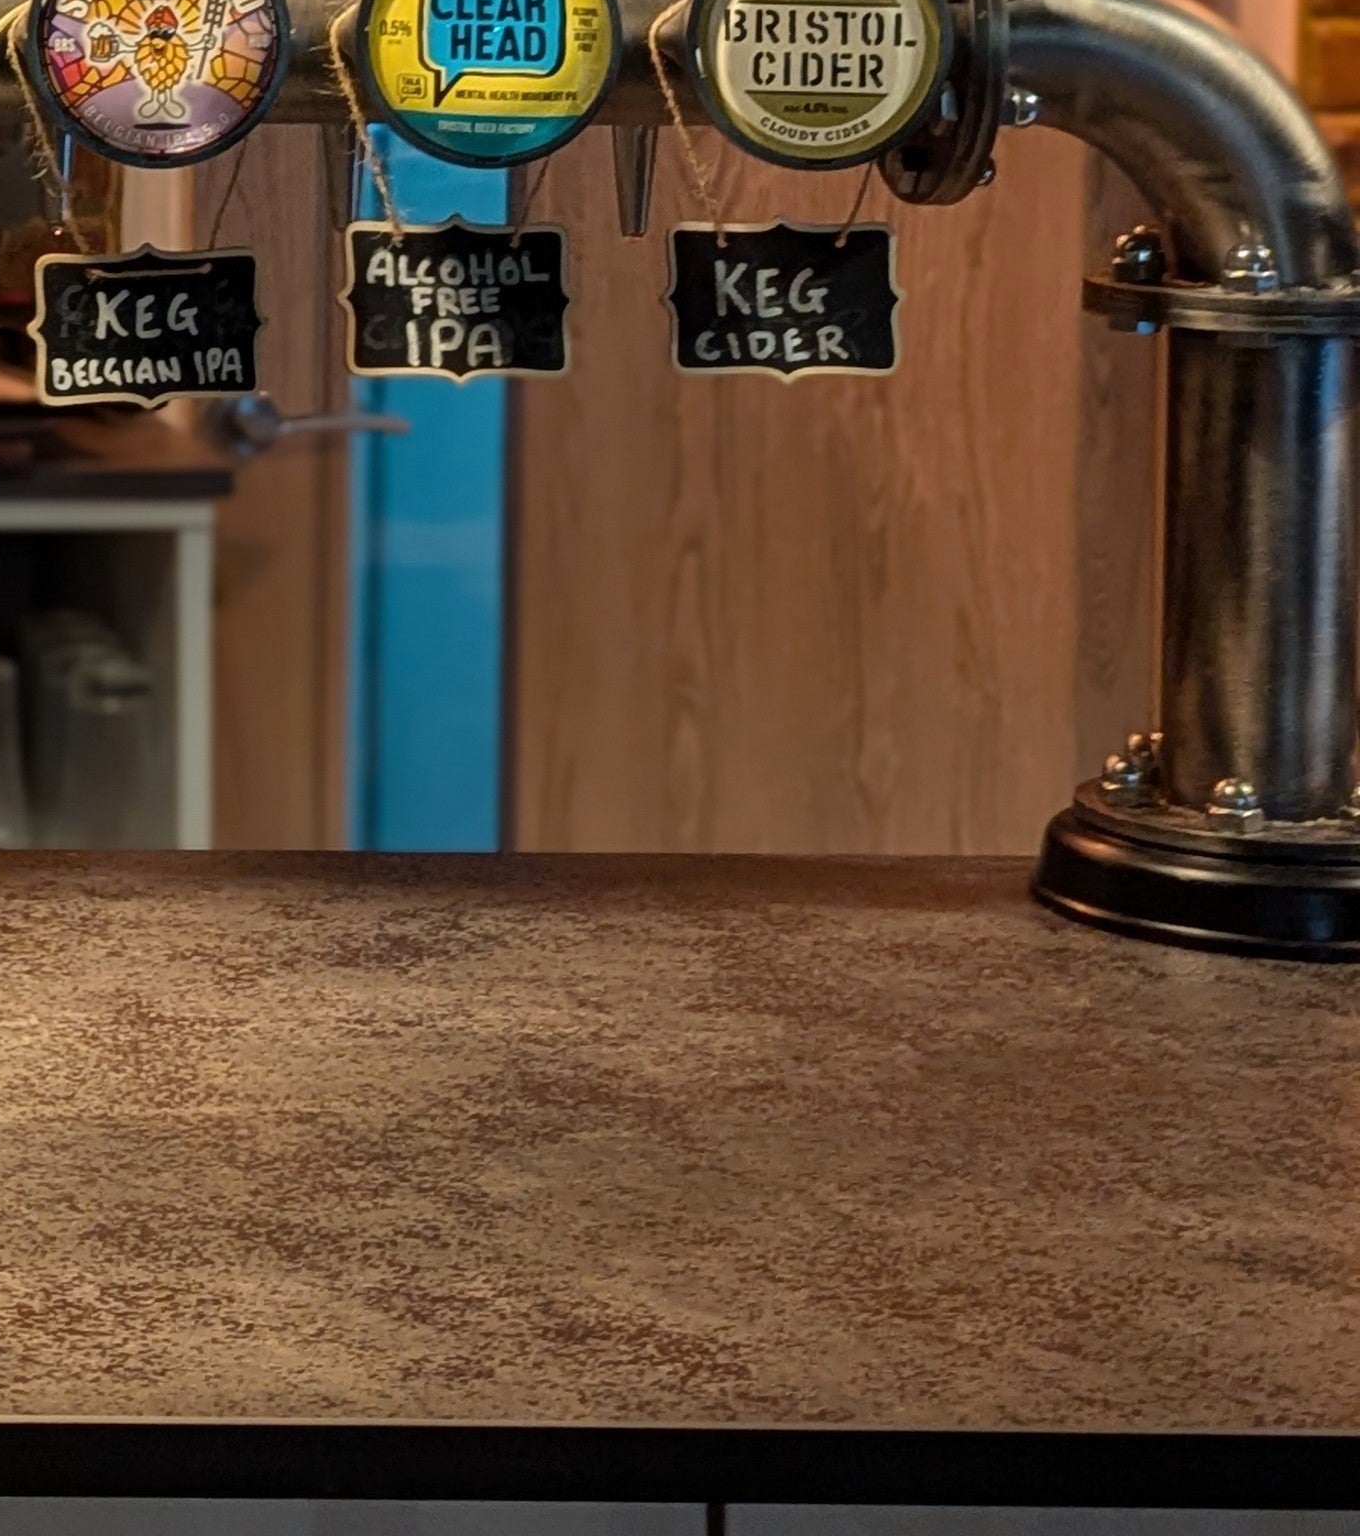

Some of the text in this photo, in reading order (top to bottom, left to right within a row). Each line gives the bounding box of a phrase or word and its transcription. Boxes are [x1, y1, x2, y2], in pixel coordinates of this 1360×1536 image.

[450, 23, 546, 62] HEAD
[724, 8, 917, 47] BRISTOL
[752, 52, 884, 88] CIDER
[83, 104, 156, 147] BELGIAN
[760, 116, 871, 142] CLOUDY CIDER
[366, 249, 550, 288] ALCOHOL
[714, 259, 829, 317] KEG
[95, 289, 199, 341] KEG
[410, 286, 502, 317] FREE
[406, 318, 503, 368] IPA
[695, 324, 850, 362] CIDER
[51, 347, 244, 391] BELGIAN IPA
